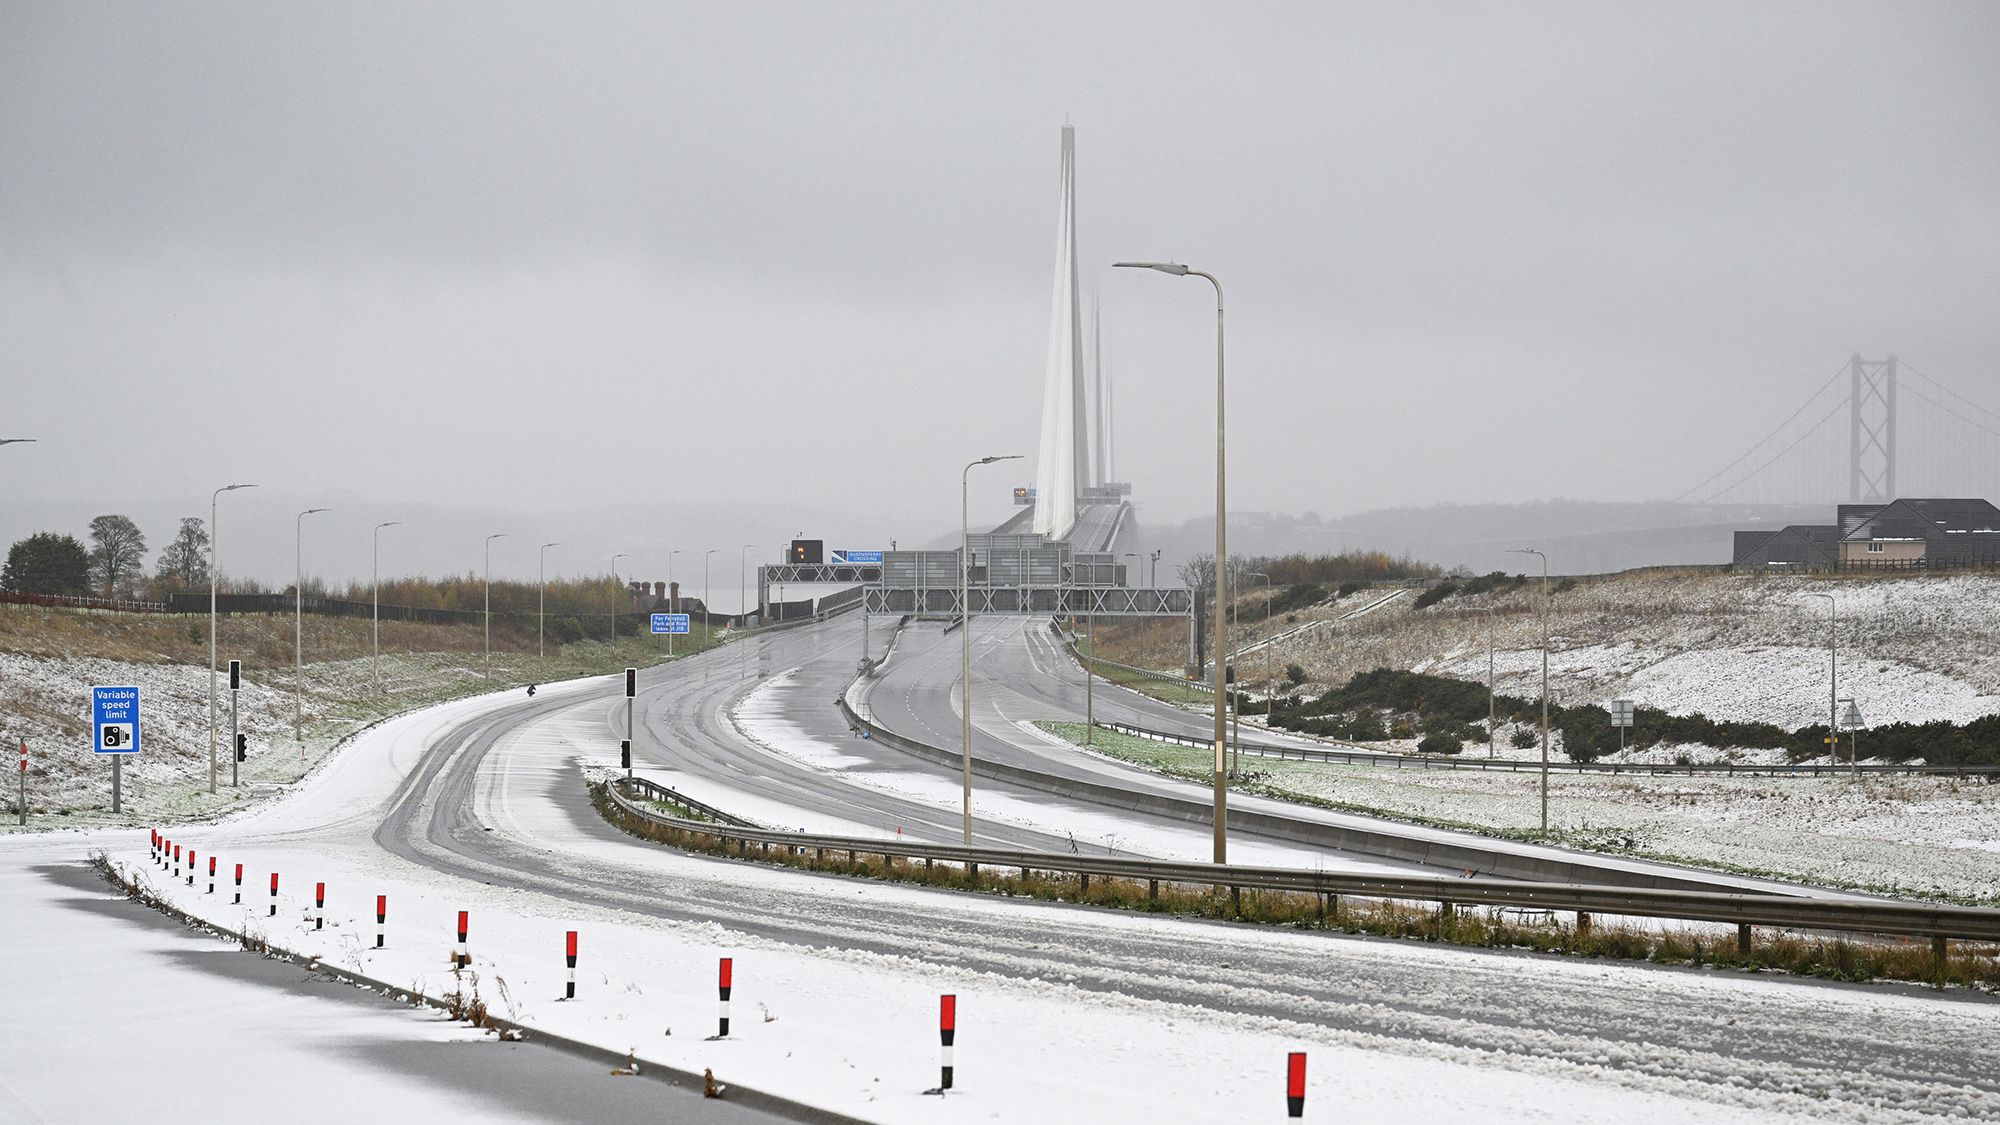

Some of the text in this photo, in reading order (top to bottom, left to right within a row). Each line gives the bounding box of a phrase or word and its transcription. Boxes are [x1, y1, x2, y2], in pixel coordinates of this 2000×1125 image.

[97, 690, 136, 699] Variable
[102, 701, 130, 710] speed
[105, 711, 127, 719] limit
